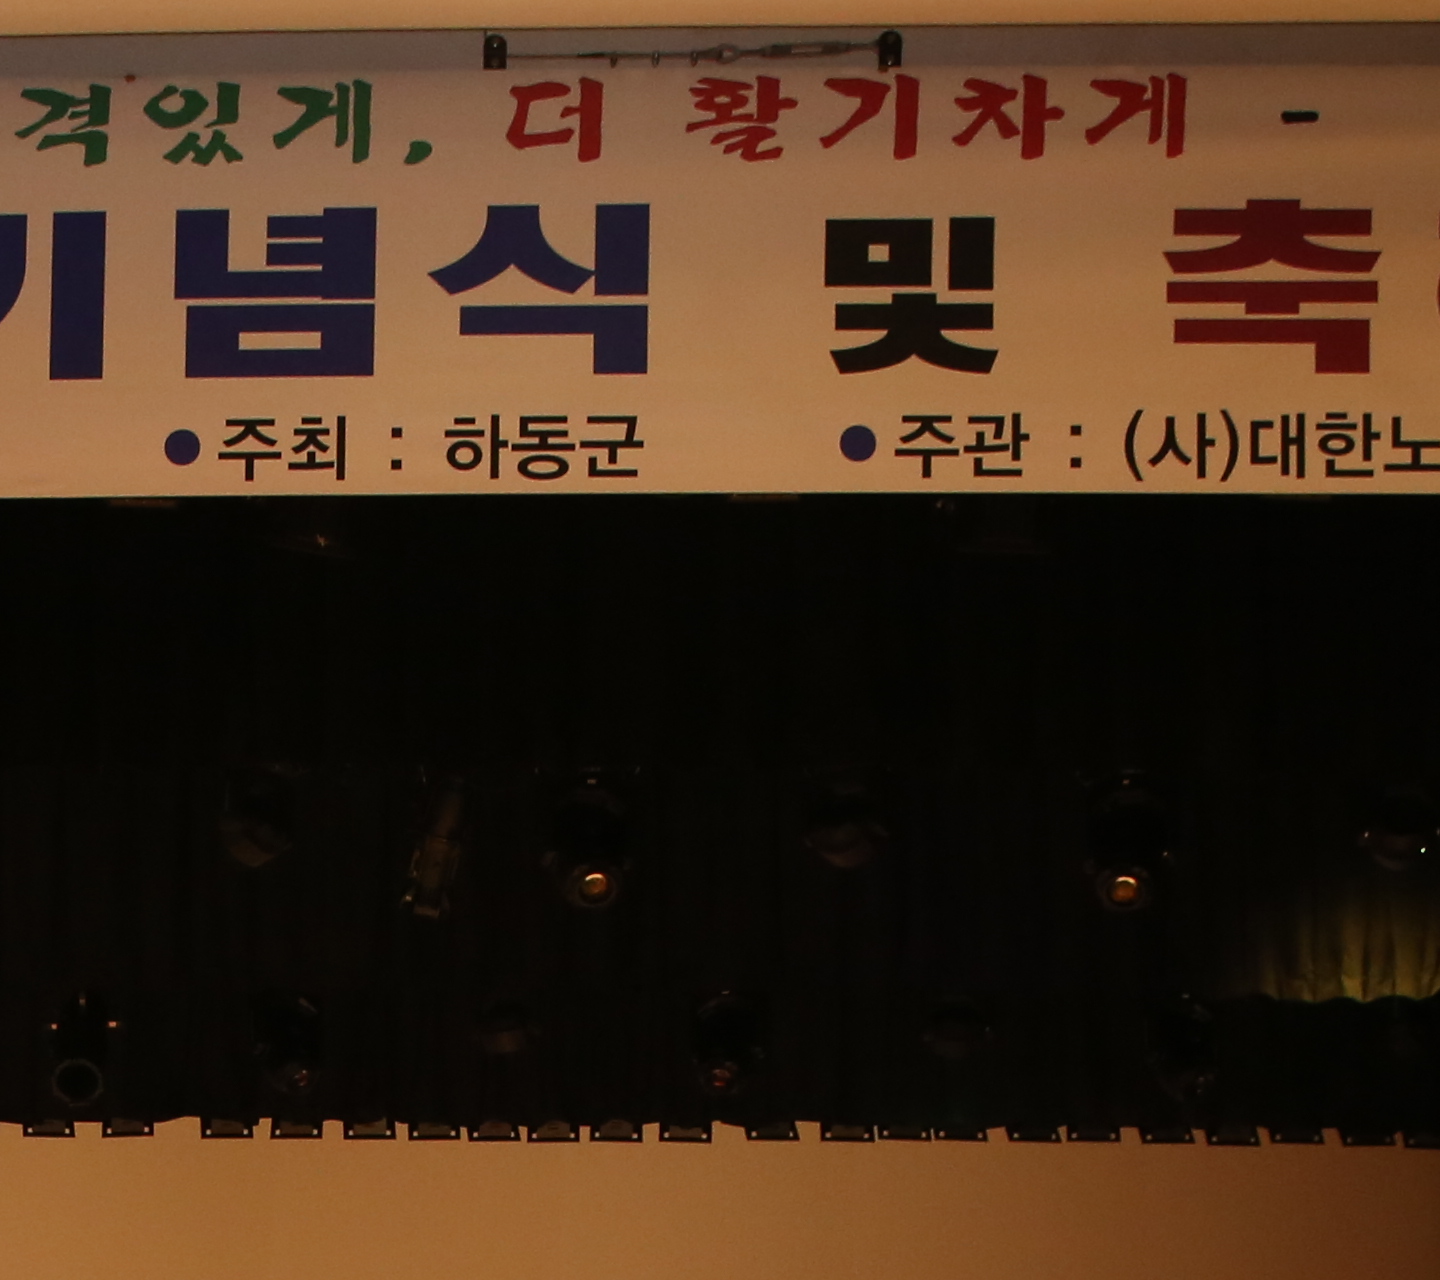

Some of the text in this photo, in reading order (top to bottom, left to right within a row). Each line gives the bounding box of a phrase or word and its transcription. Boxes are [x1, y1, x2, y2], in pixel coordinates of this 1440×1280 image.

[504, 76, 603, 162] 더
[684, 74, 1188, 161] 활기차게
[825, 217, 998, 374] 및
[218, 416, 345, 481] 주최
[445, 415, 644, 480] 하동군
[895, 413, 1029, 478] 주관
